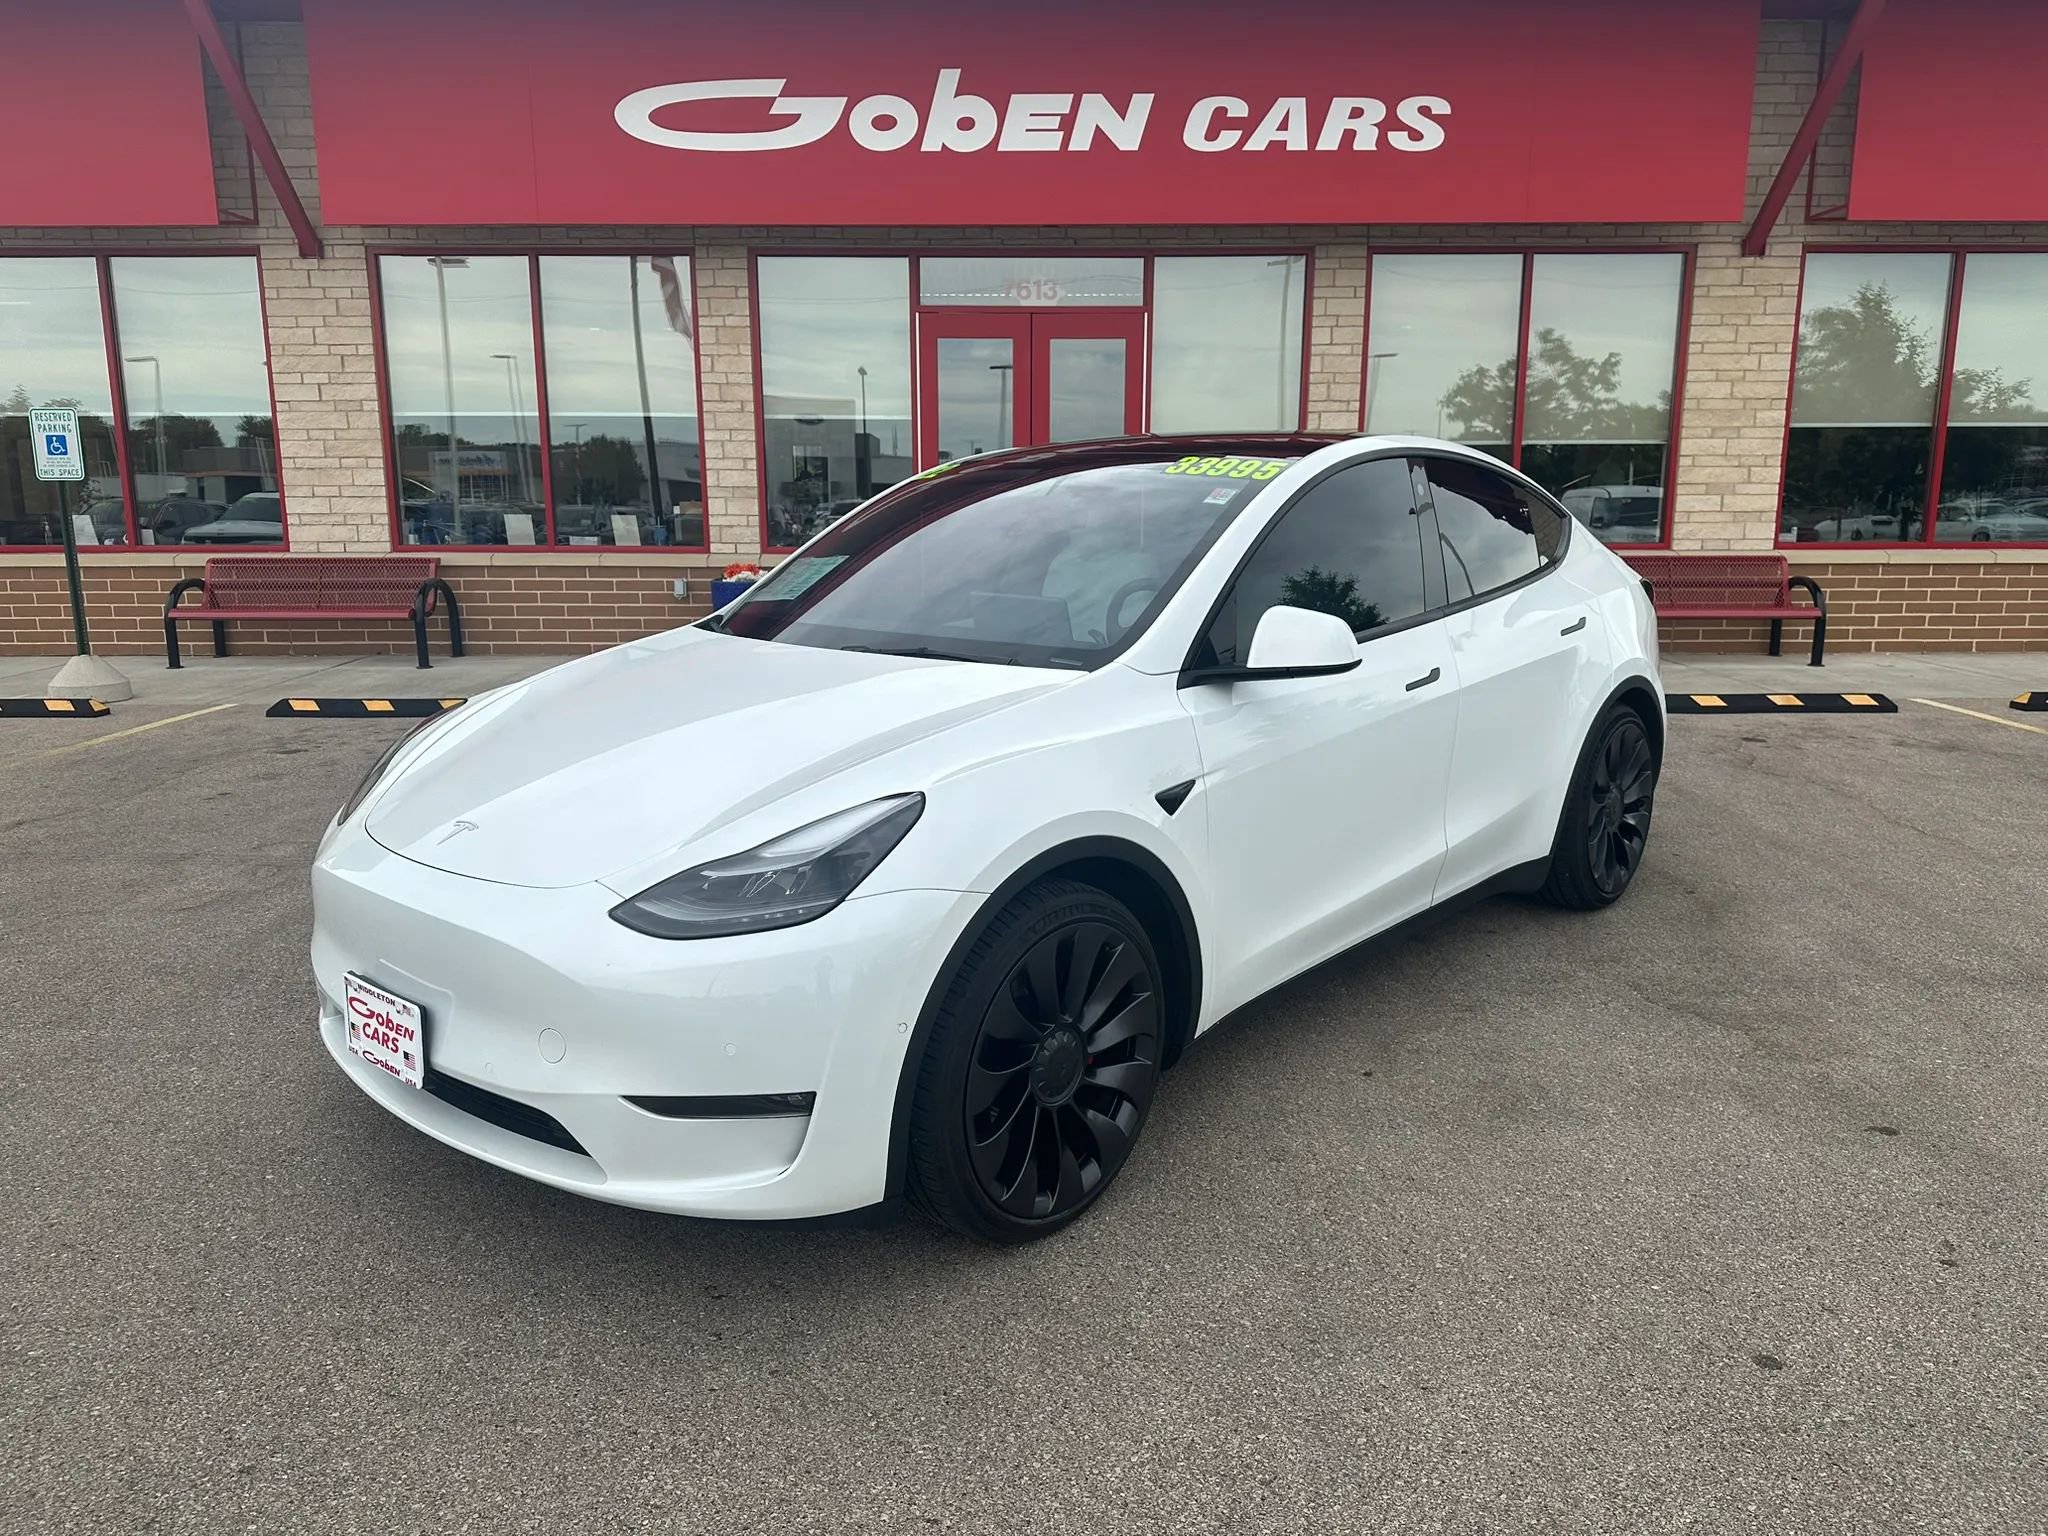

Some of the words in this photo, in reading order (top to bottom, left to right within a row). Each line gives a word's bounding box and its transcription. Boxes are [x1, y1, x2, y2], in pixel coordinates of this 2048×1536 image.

[1183, 95, 1452, 153] CARS
[34, 412, 72, 422] RESERVED
[37, 423, 72, 433] PARKING
[40, 468, 55, 476] THIS
[59, 468, 80, 476] SPACE
[1164, 455, 1289, 481] 33995
[357, 982, 396, 1007] MIDDLETON
[362, 1022, 400, 1054] CARS
[348, 1044, 359, 1056] USA
[405, 1076, 417, 1088] USA
